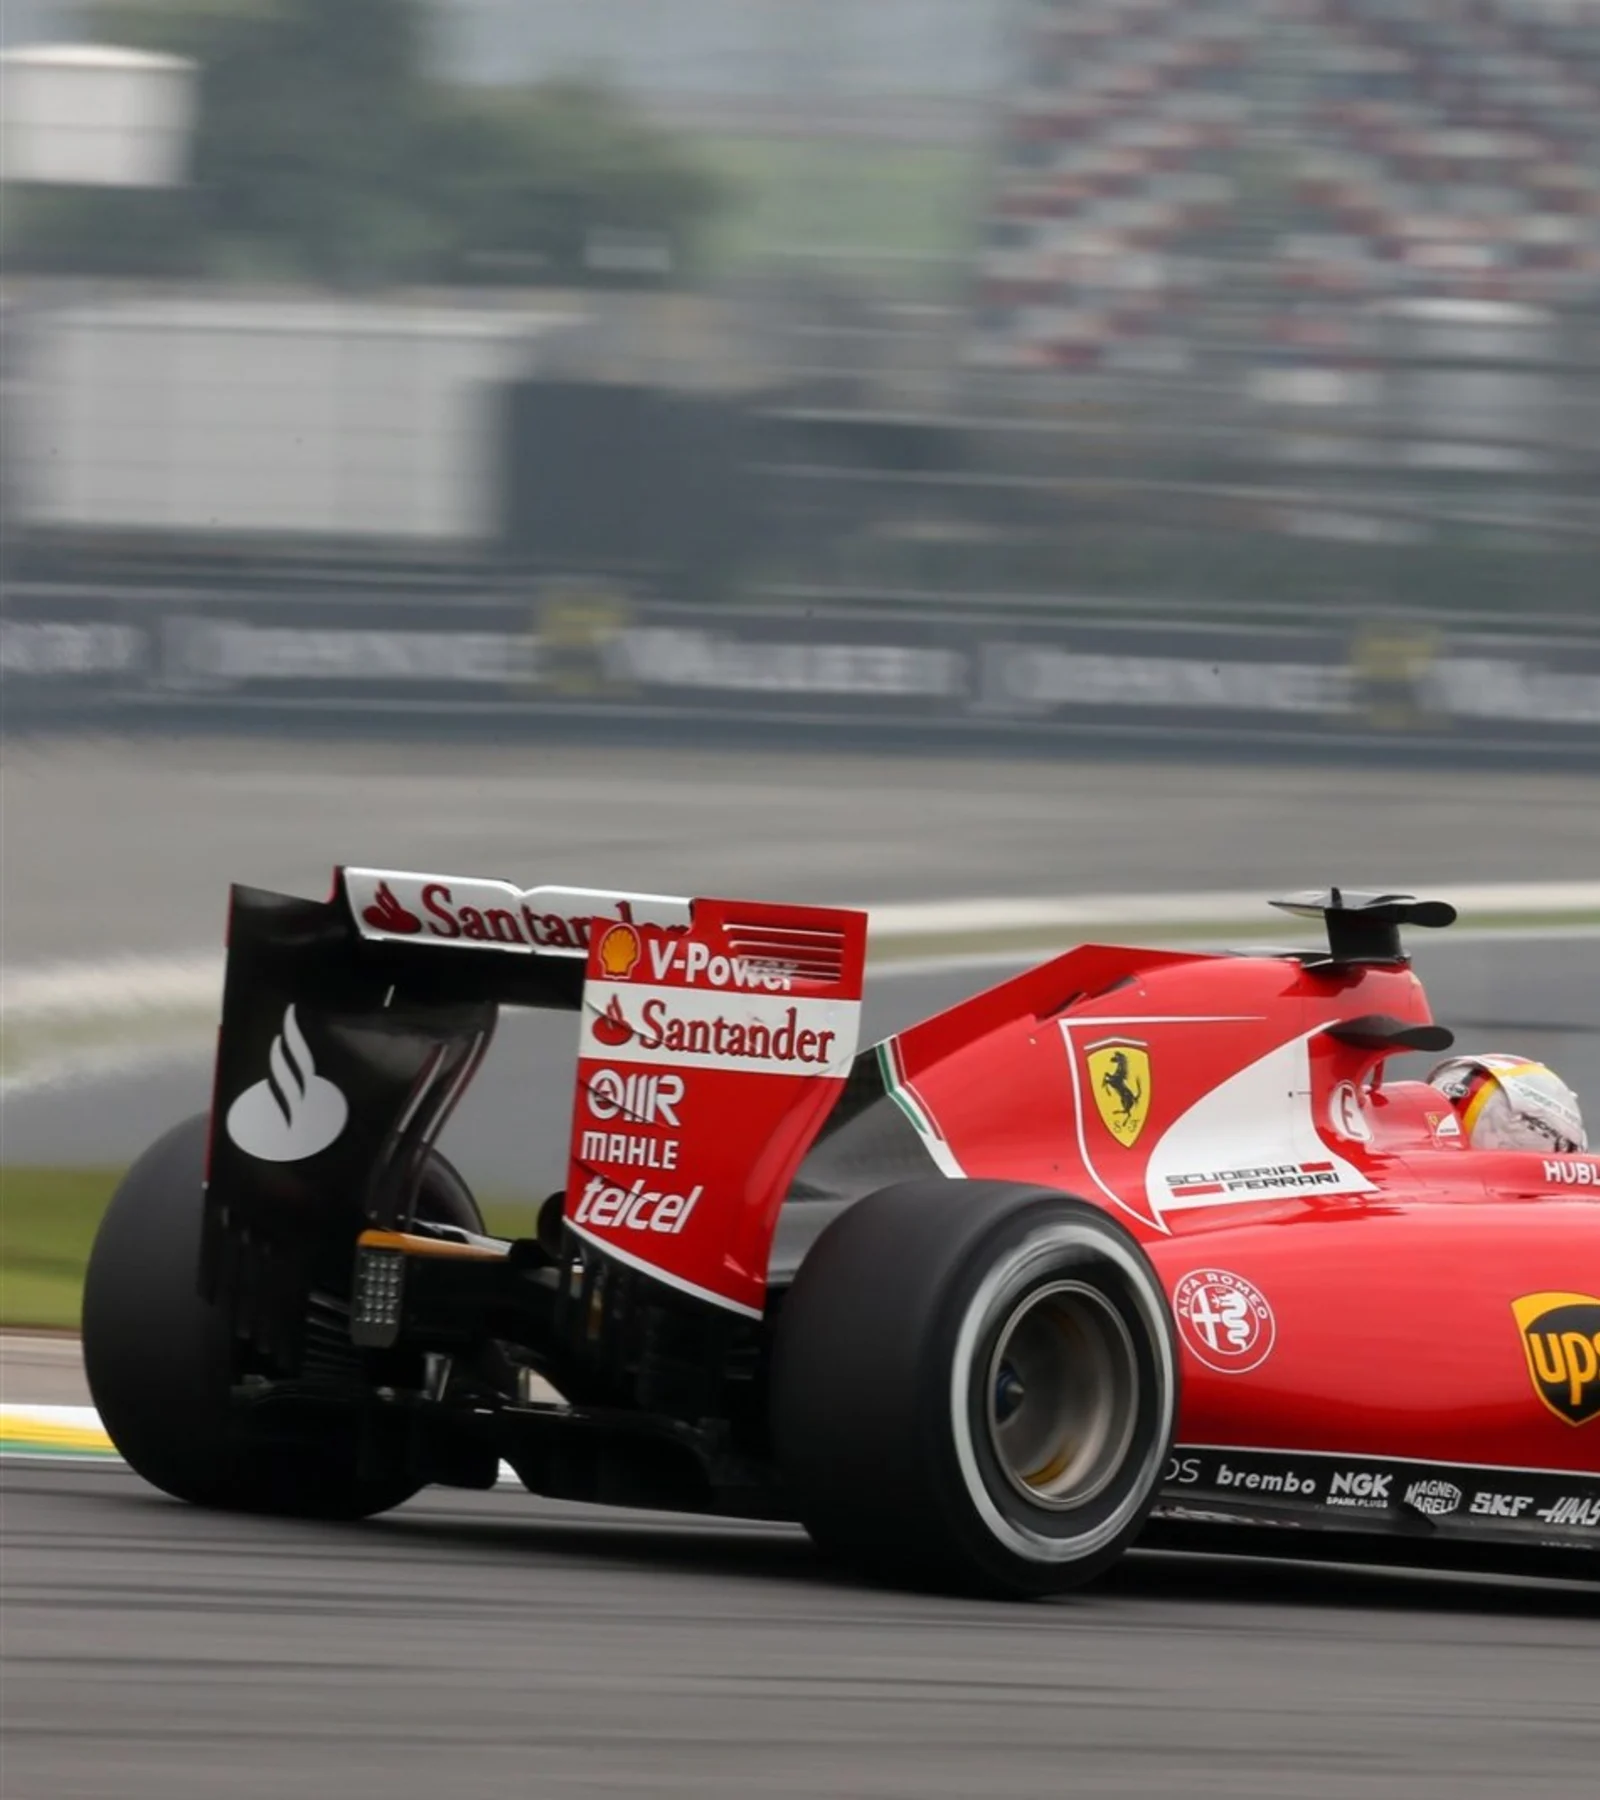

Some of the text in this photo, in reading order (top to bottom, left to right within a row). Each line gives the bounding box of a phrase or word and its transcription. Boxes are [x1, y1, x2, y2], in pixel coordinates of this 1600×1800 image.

[638, 999, 835, 1064] Santander
[580, 1131, 679, 1170] MAHLE
[1165, 1164, 1298, 1186] SCUDERIA
[1227, 1172, 1340, 1192] FERRARI
[574, 1175, 704, 1234] telcel
[1178, 1272, 1269, 1321] ALFA ROMEO
[1216, 1464, 1316, 1494] brembo
[1329, 1472, 1393, 1498] NGK
[1326, 1496, 1355, 1506] SPARK
[1469, 1492, 1534, 1517] SKF
